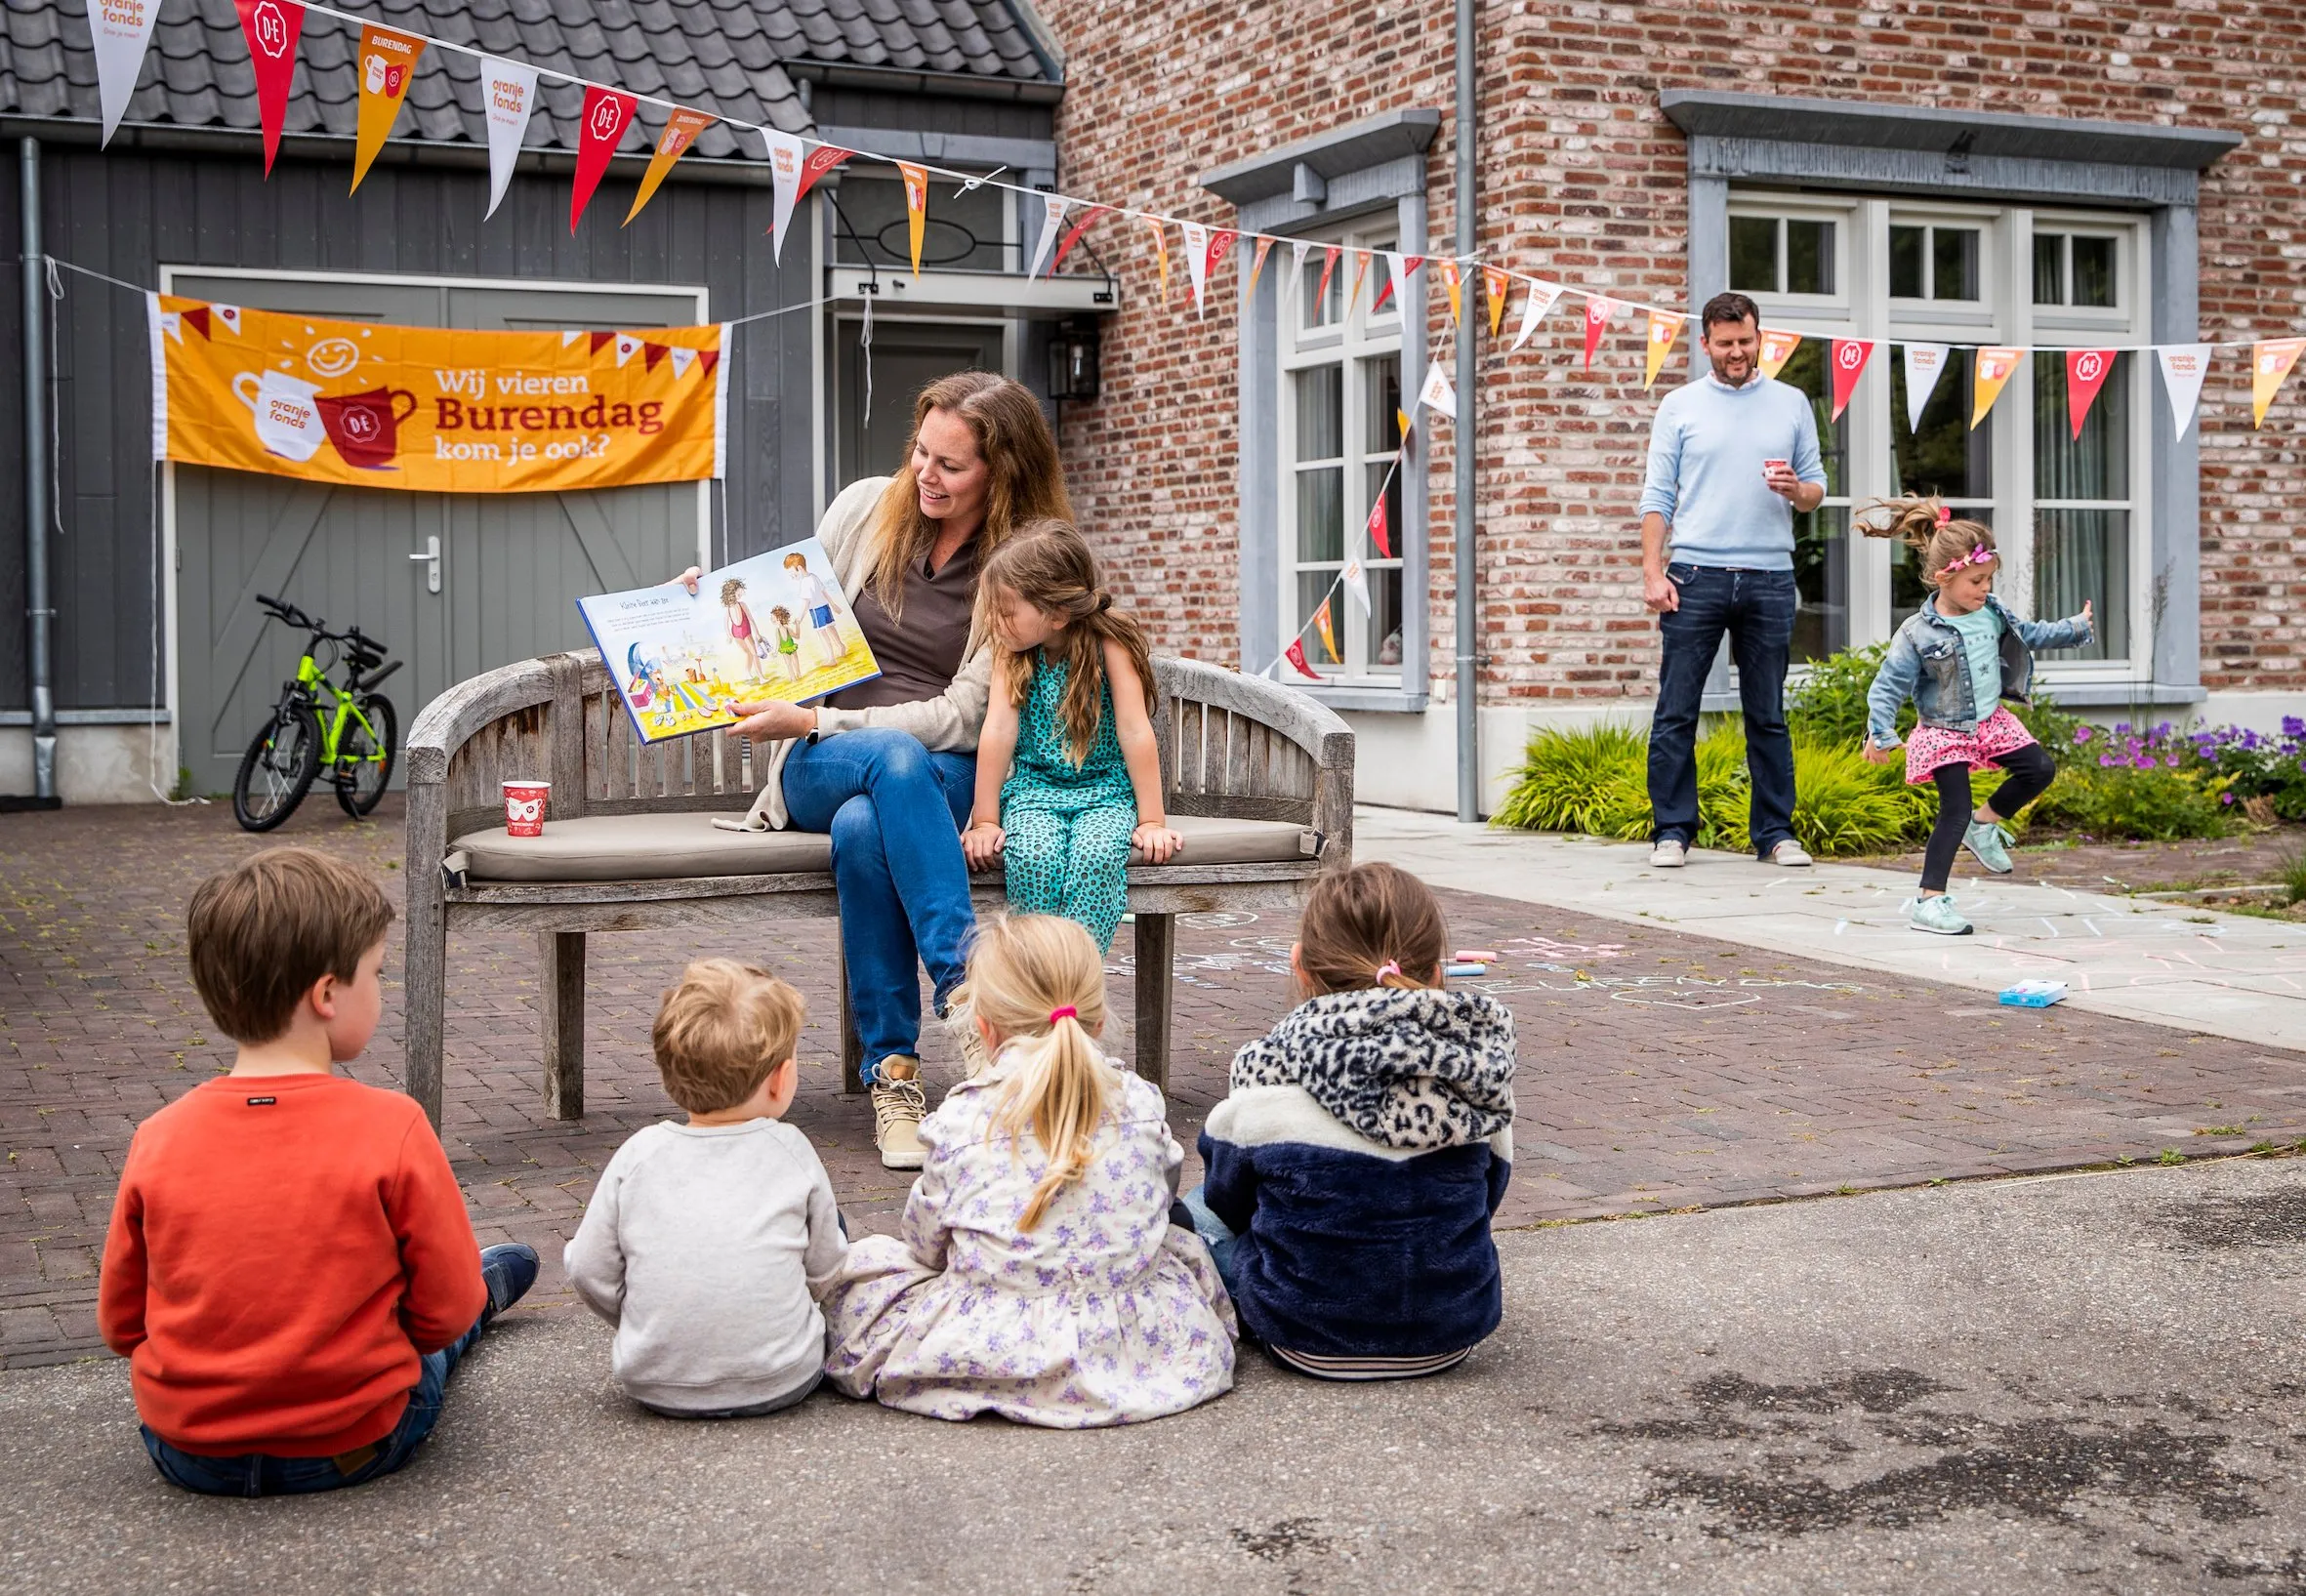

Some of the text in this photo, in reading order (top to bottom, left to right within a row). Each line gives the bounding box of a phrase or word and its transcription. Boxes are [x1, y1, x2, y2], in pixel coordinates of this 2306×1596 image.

[103, 9, 144, 27] fonds
[372, 35, 412, 55] BURENDAG
[492, 78, 524, 97] oranje
[493, 93, 522, 113] fonds
[433, 369, 590, 401] Wij vieren
[269, 409, 307, 430] fonds
[270, 399, 311, 421] oranje
[434, 394, 665, 435] Burendag
[434, 433, 611, 467] kom je ook?
[1459, 976, 1864, 994] BURENDAG
